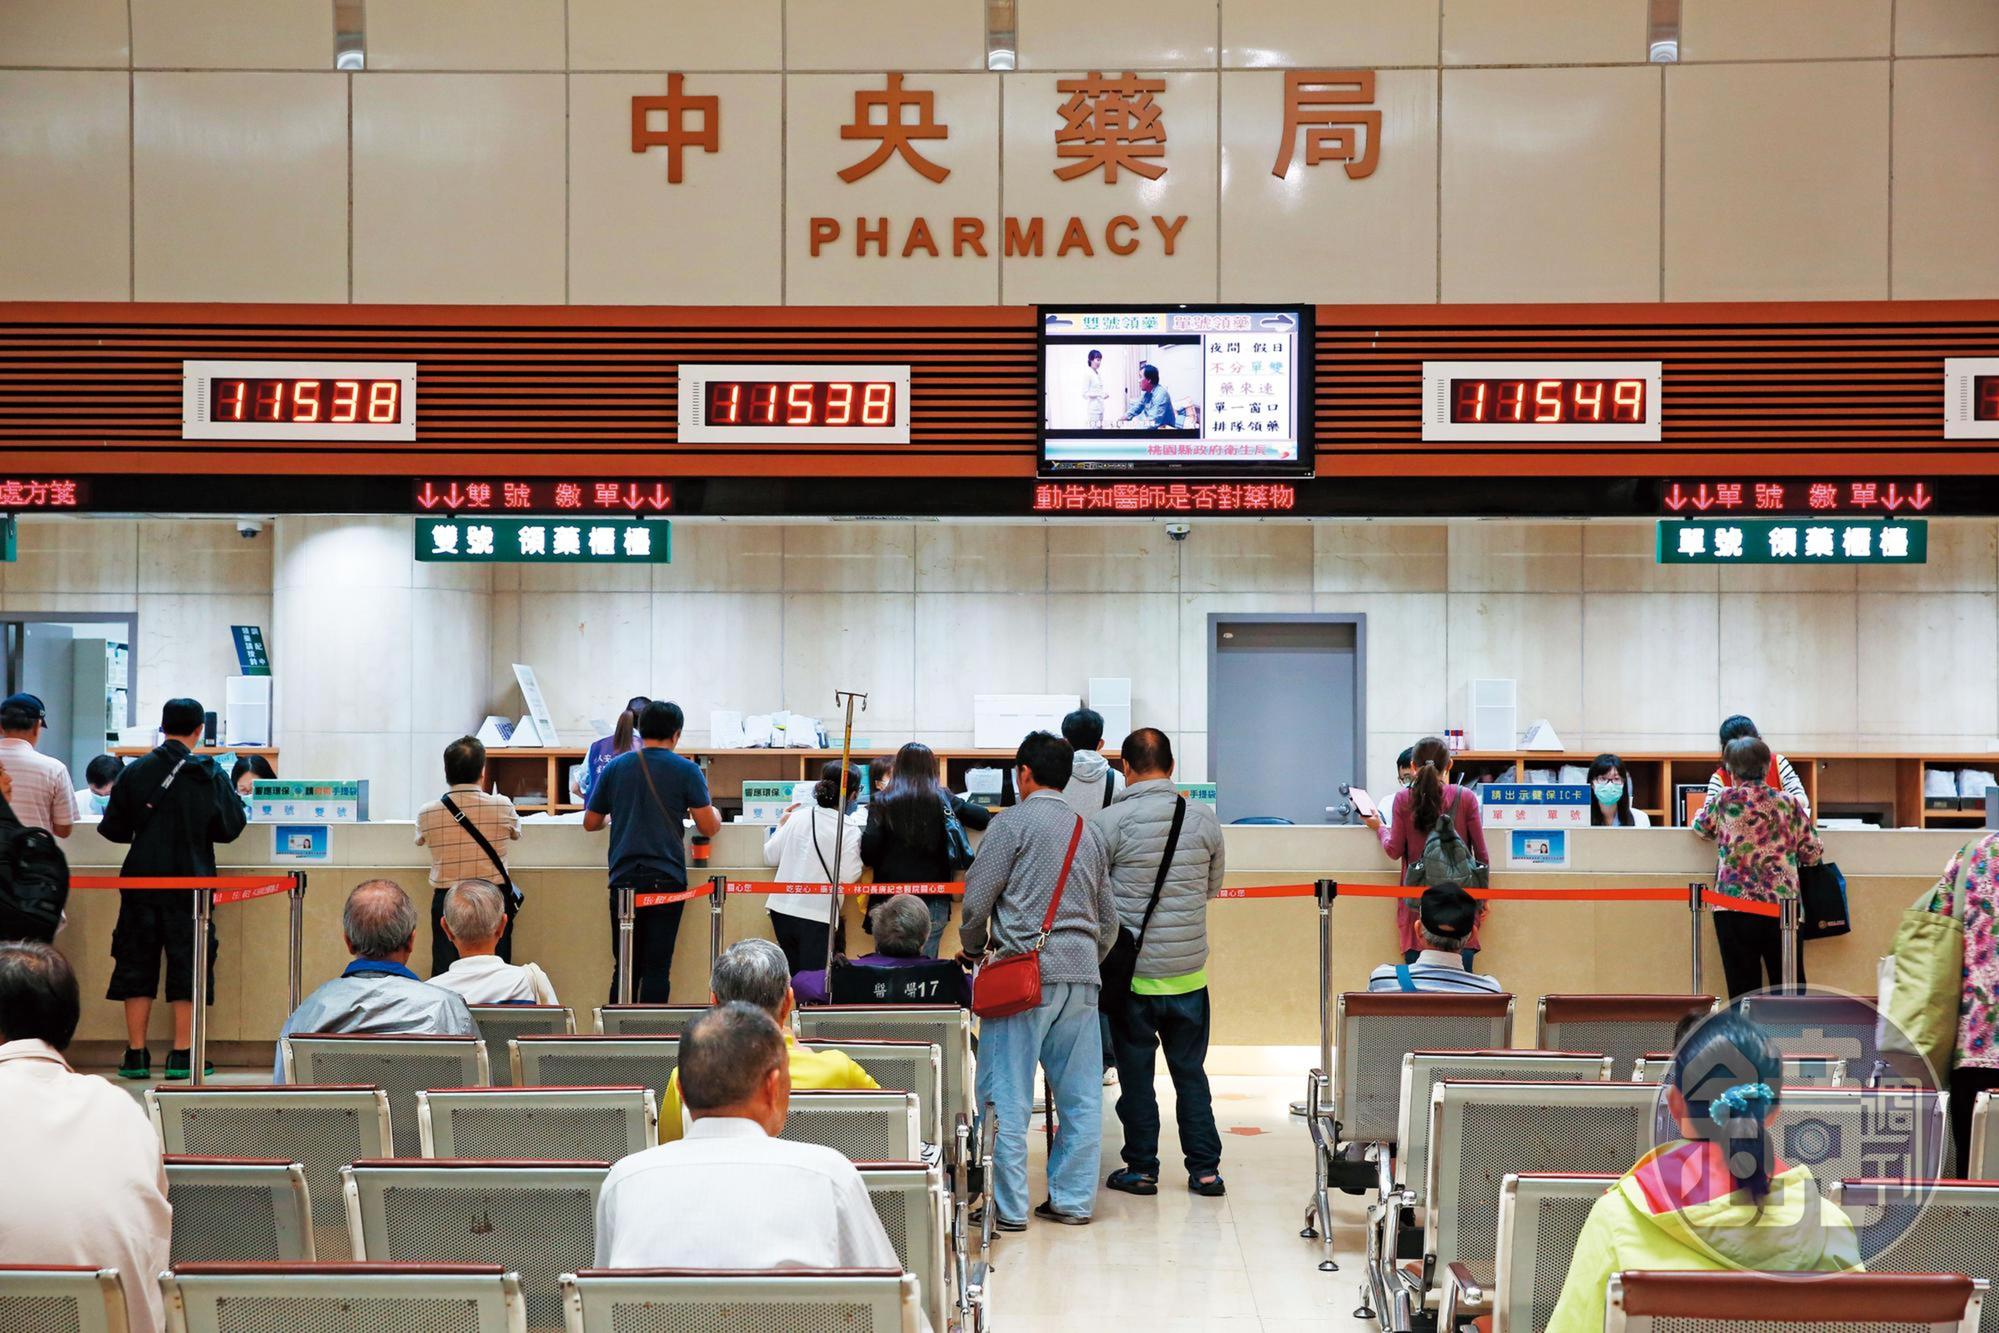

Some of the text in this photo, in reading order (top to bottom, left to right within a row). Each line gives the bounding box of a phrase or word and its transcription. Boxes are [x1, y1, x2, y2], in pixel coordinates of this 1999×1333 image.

[631, 71, 1383, 184] 中央藥局
[810, 215, 1188, 257] PHARMACY
[232, 382, 397, 422] 11538
[729, 384, 891, 424] 11538
[1473, 381, 1642, 422] 11549
